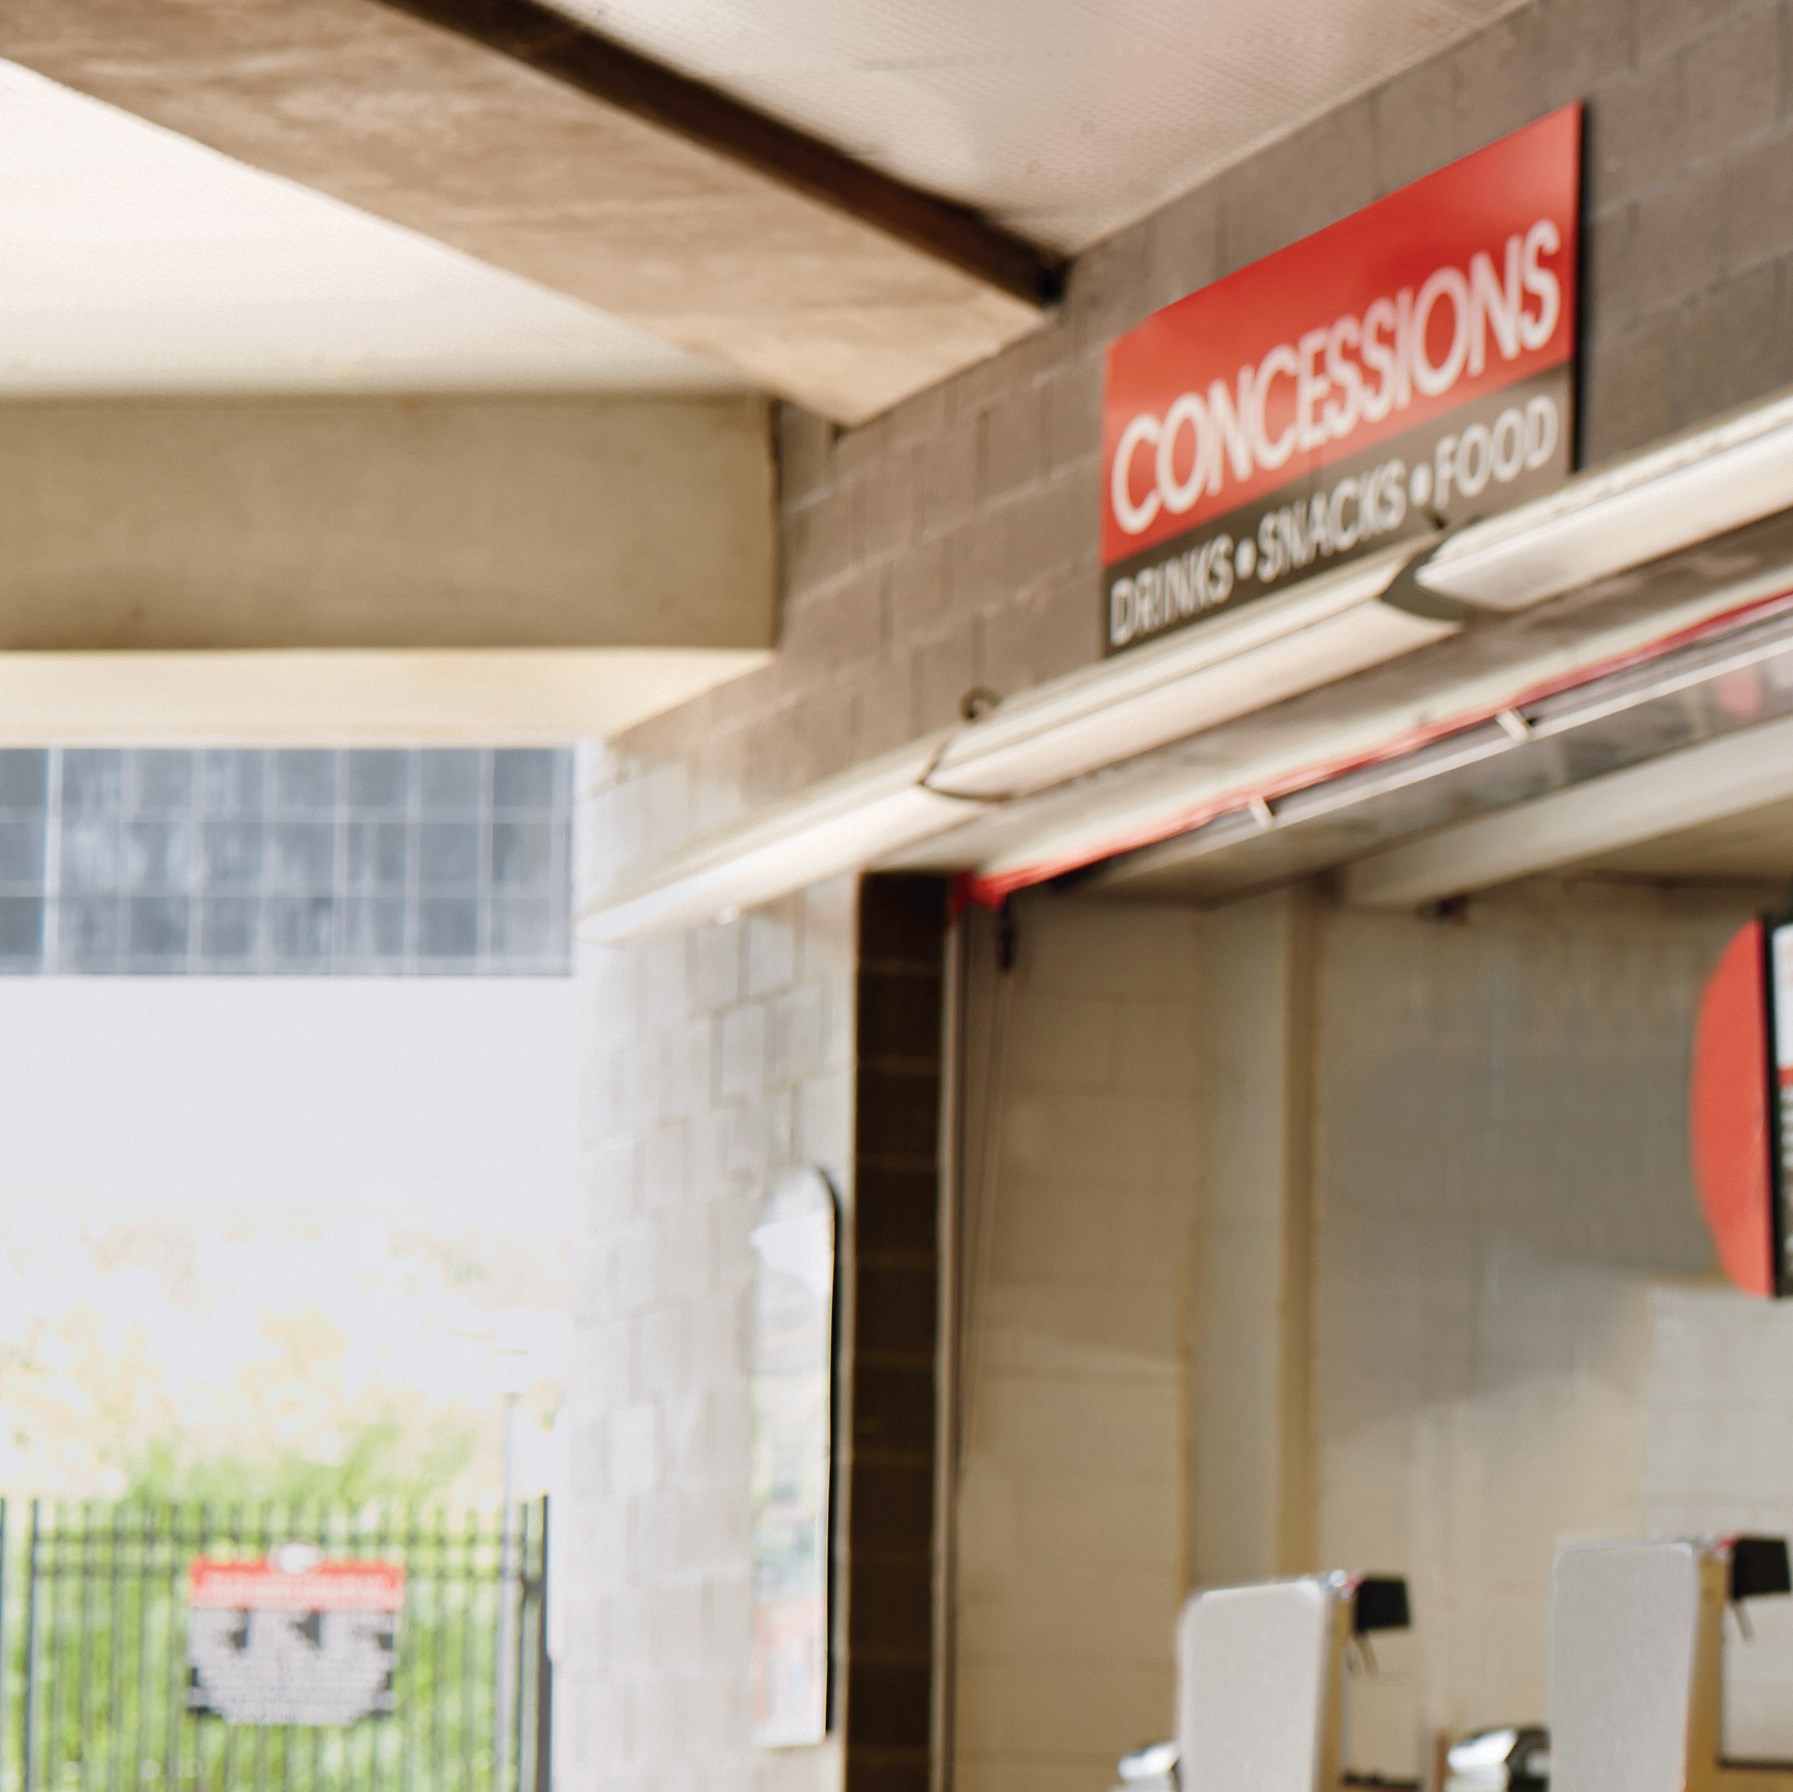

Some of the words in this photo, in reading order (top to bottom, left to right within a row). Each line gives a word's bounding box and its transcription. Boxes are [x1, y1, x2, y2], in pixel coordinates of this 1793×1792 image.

[1111, 219, 1560, 535] CONCESSIONS
[1110, 533, 1233, 646] DRINKS
[1256, 458, 1407, 583] SNACKS
[1434, 395, 1558, 509] FOOD
